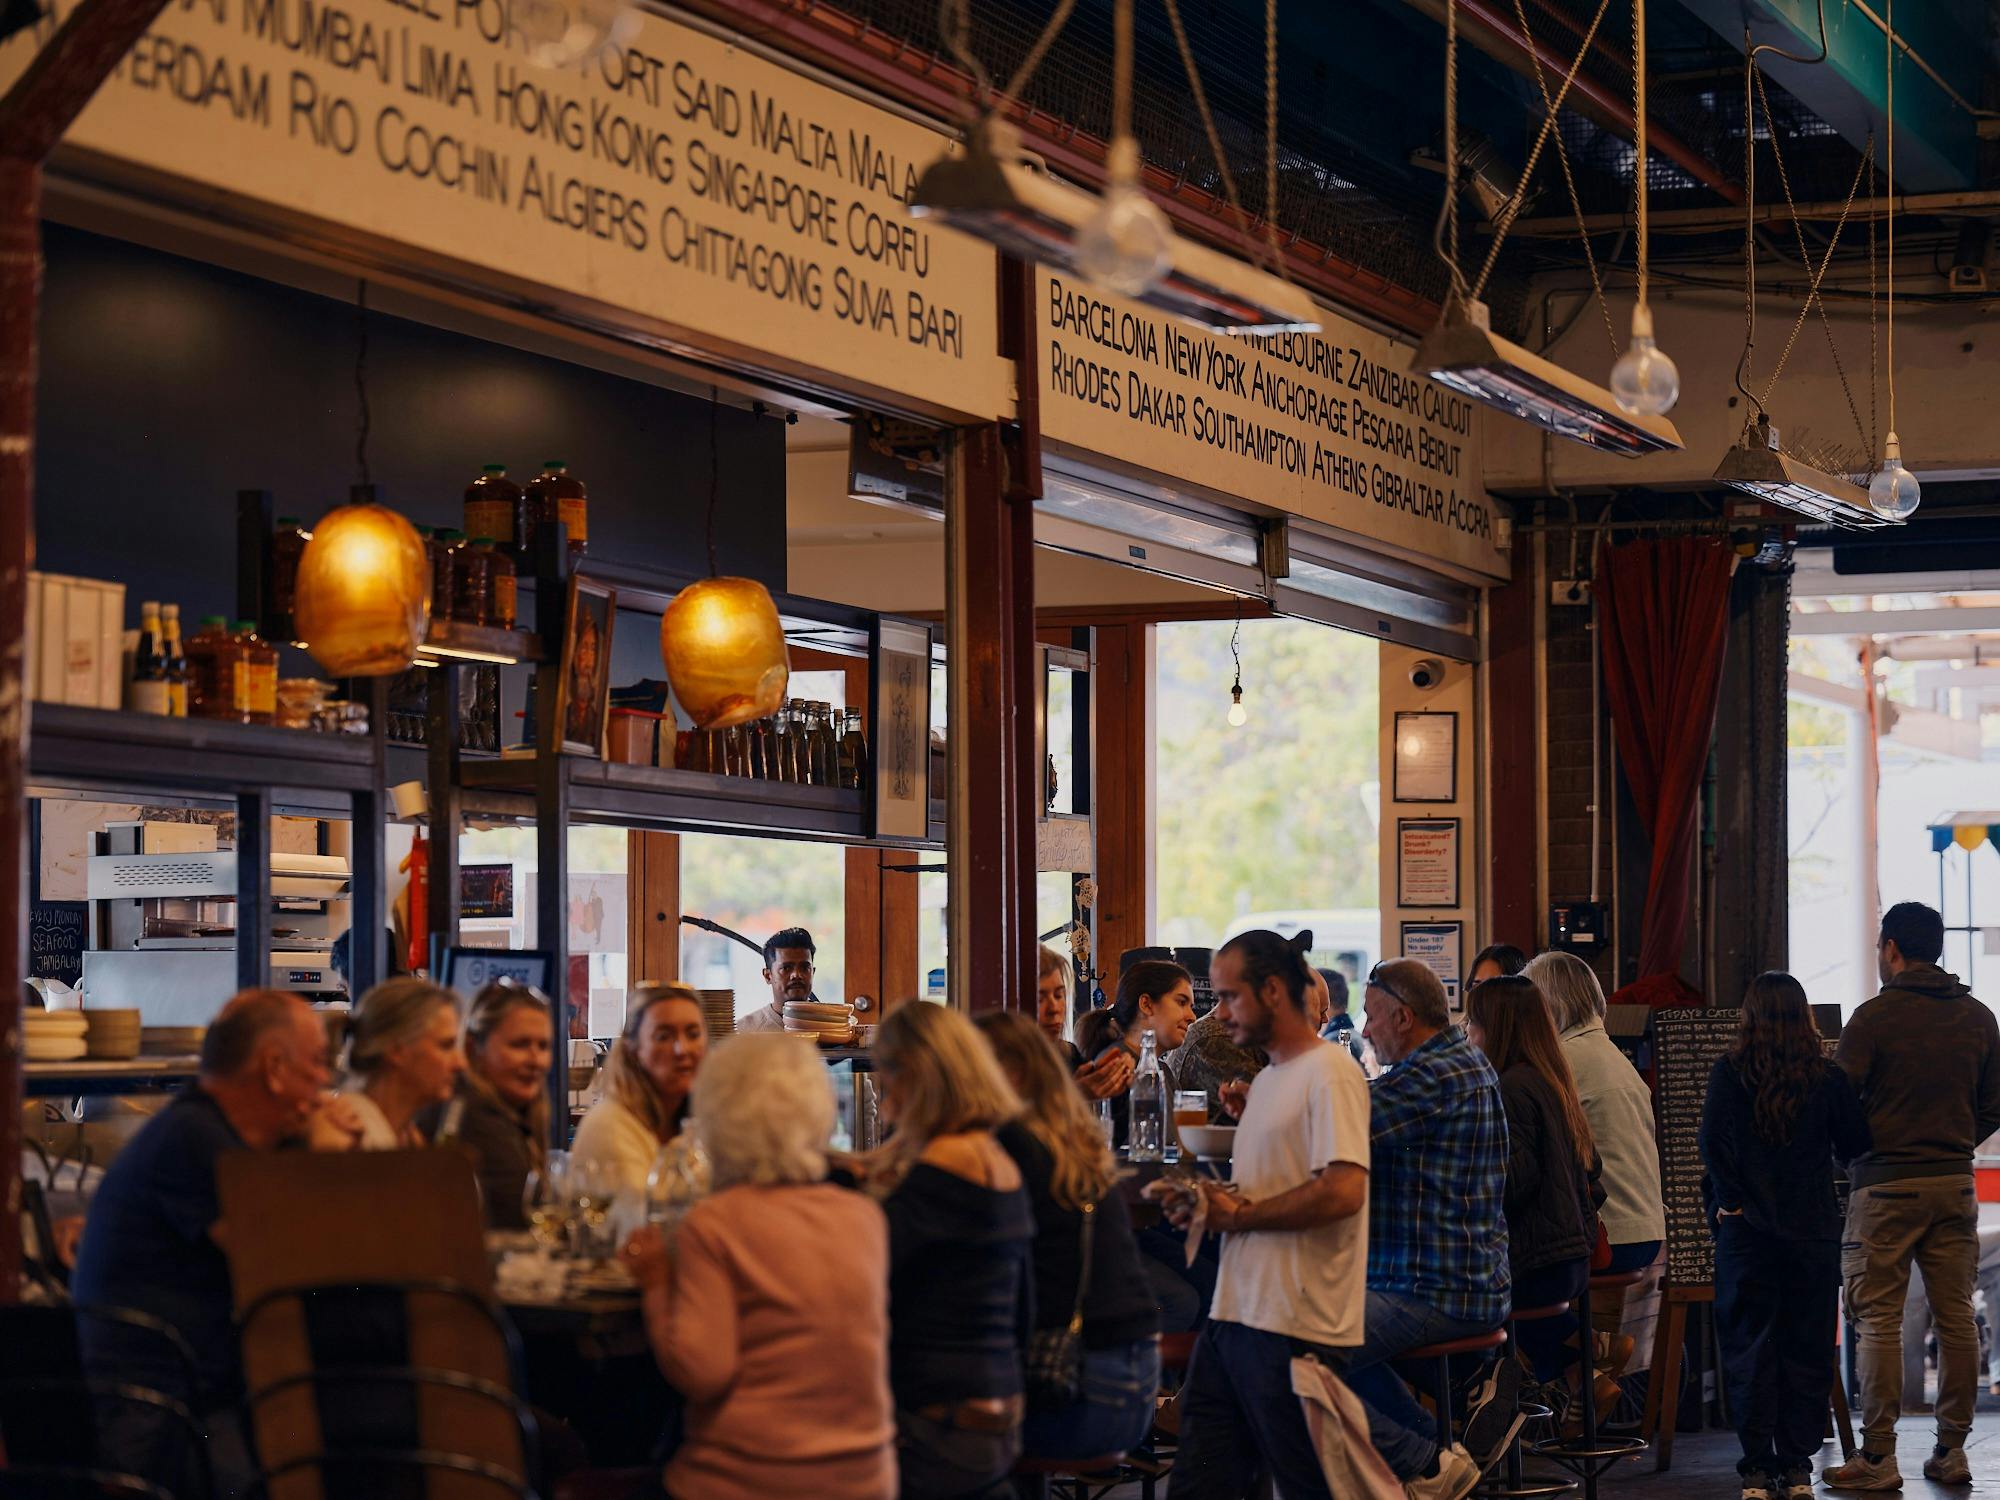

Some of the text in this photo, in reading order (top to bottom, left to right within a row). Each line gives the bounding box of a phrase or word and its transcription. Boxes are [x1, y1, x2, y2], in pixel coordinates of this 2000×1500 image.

[242, 0, 930, 279] MUMBAI LIMA HONG KONG SINGAPORE CORFU
[288, 72, 360, 156] RIO
[375, 105, 508, 205] COCHIN
[518, 155, 647, 250] ALGIERS
[660, 206, 823, 311] CHITTAGONG
[833, 266, 898, 338] SUVA
[907, 291, 965, 360] BARI
[582, 42, 665, 108] ORT
[671, 61, 741, 139] SAID
[749, 89, 842, 178] MALTA
[848, 128, 918, 204] MALA
[1049, 278, 1461, 479] BARCELONA NEW YORK ANCHORAGE PESCARA BEIRUT
[1050, 341, 1492, 541] RHODES DAKAR SOUTHAMPTON ATHENS GIBRALTAR ACCRA
[1347, 348, 1420, 417] ZANZIBAR
[1422, 384, 1472, 438] CALICUT
[32, 932, 77, 952] SEAFOOD
